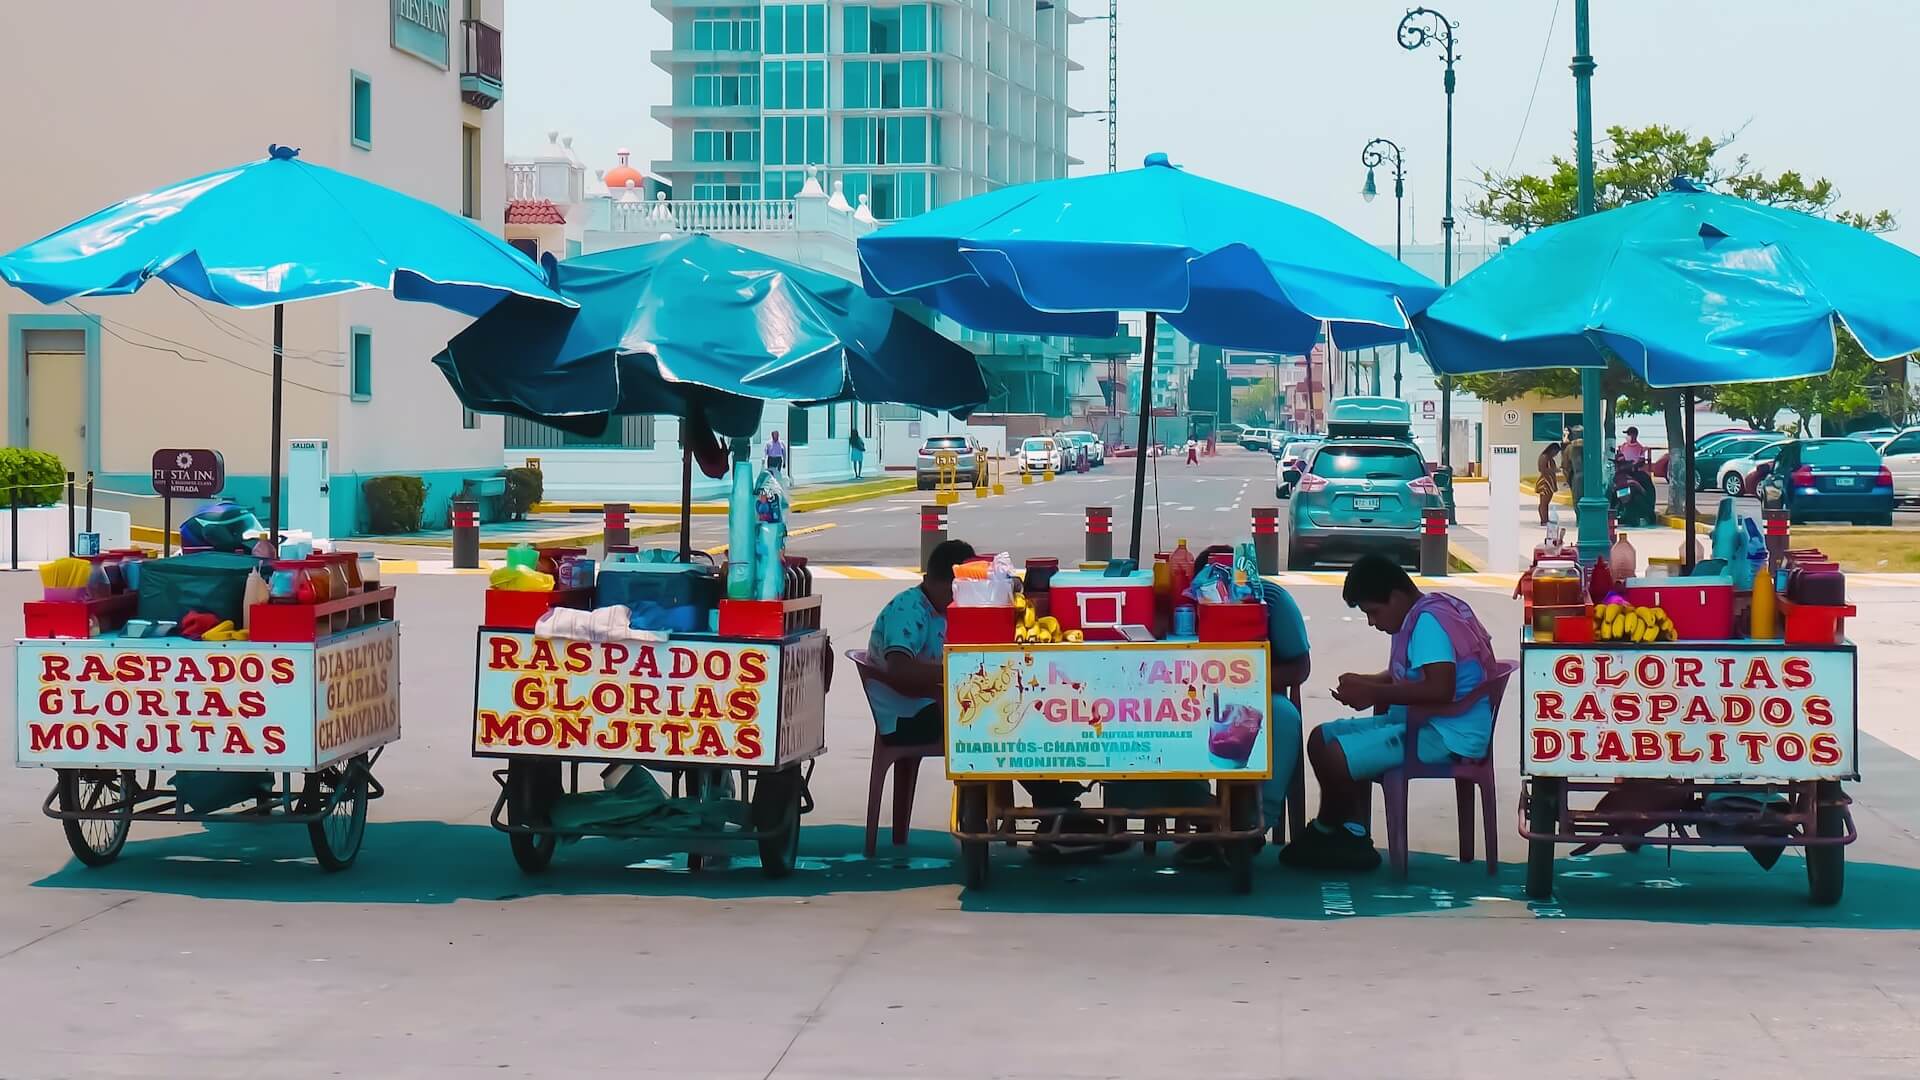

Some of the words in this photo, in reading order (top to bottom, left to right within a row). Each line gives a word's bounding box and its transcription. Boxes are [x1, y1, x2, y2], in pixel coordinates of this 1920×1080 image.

[154, 469, 190, 480] FISTA
[41, 654, 295, 685] RASPADOS
[320, 640, 393, 681] DIABLITOS
[489, 636, 767, 685] RASPADOS
[1554, 655, 1813, 690] GLORIAS
[38, 688, 267, 718] GLORIAS
[327, 670, 388, 710] GLORIAS
[514, 676, 758, 722] GLORIAS
[319, 700, 396, 749] CHAMOYADAS
[1044, 697, 1201, 723] GLORIAS
[1538, 692, 1833, 726] RASPADOS
[30, 722, 286, 754] MONJITAS
[481, 712, 763, 761] MONJITAS
[1136, 731, 1193, 739] NATURALES
[1531, 729, 1841, 765] DIABLITOS
[996, 757, 1006, 768] Y
